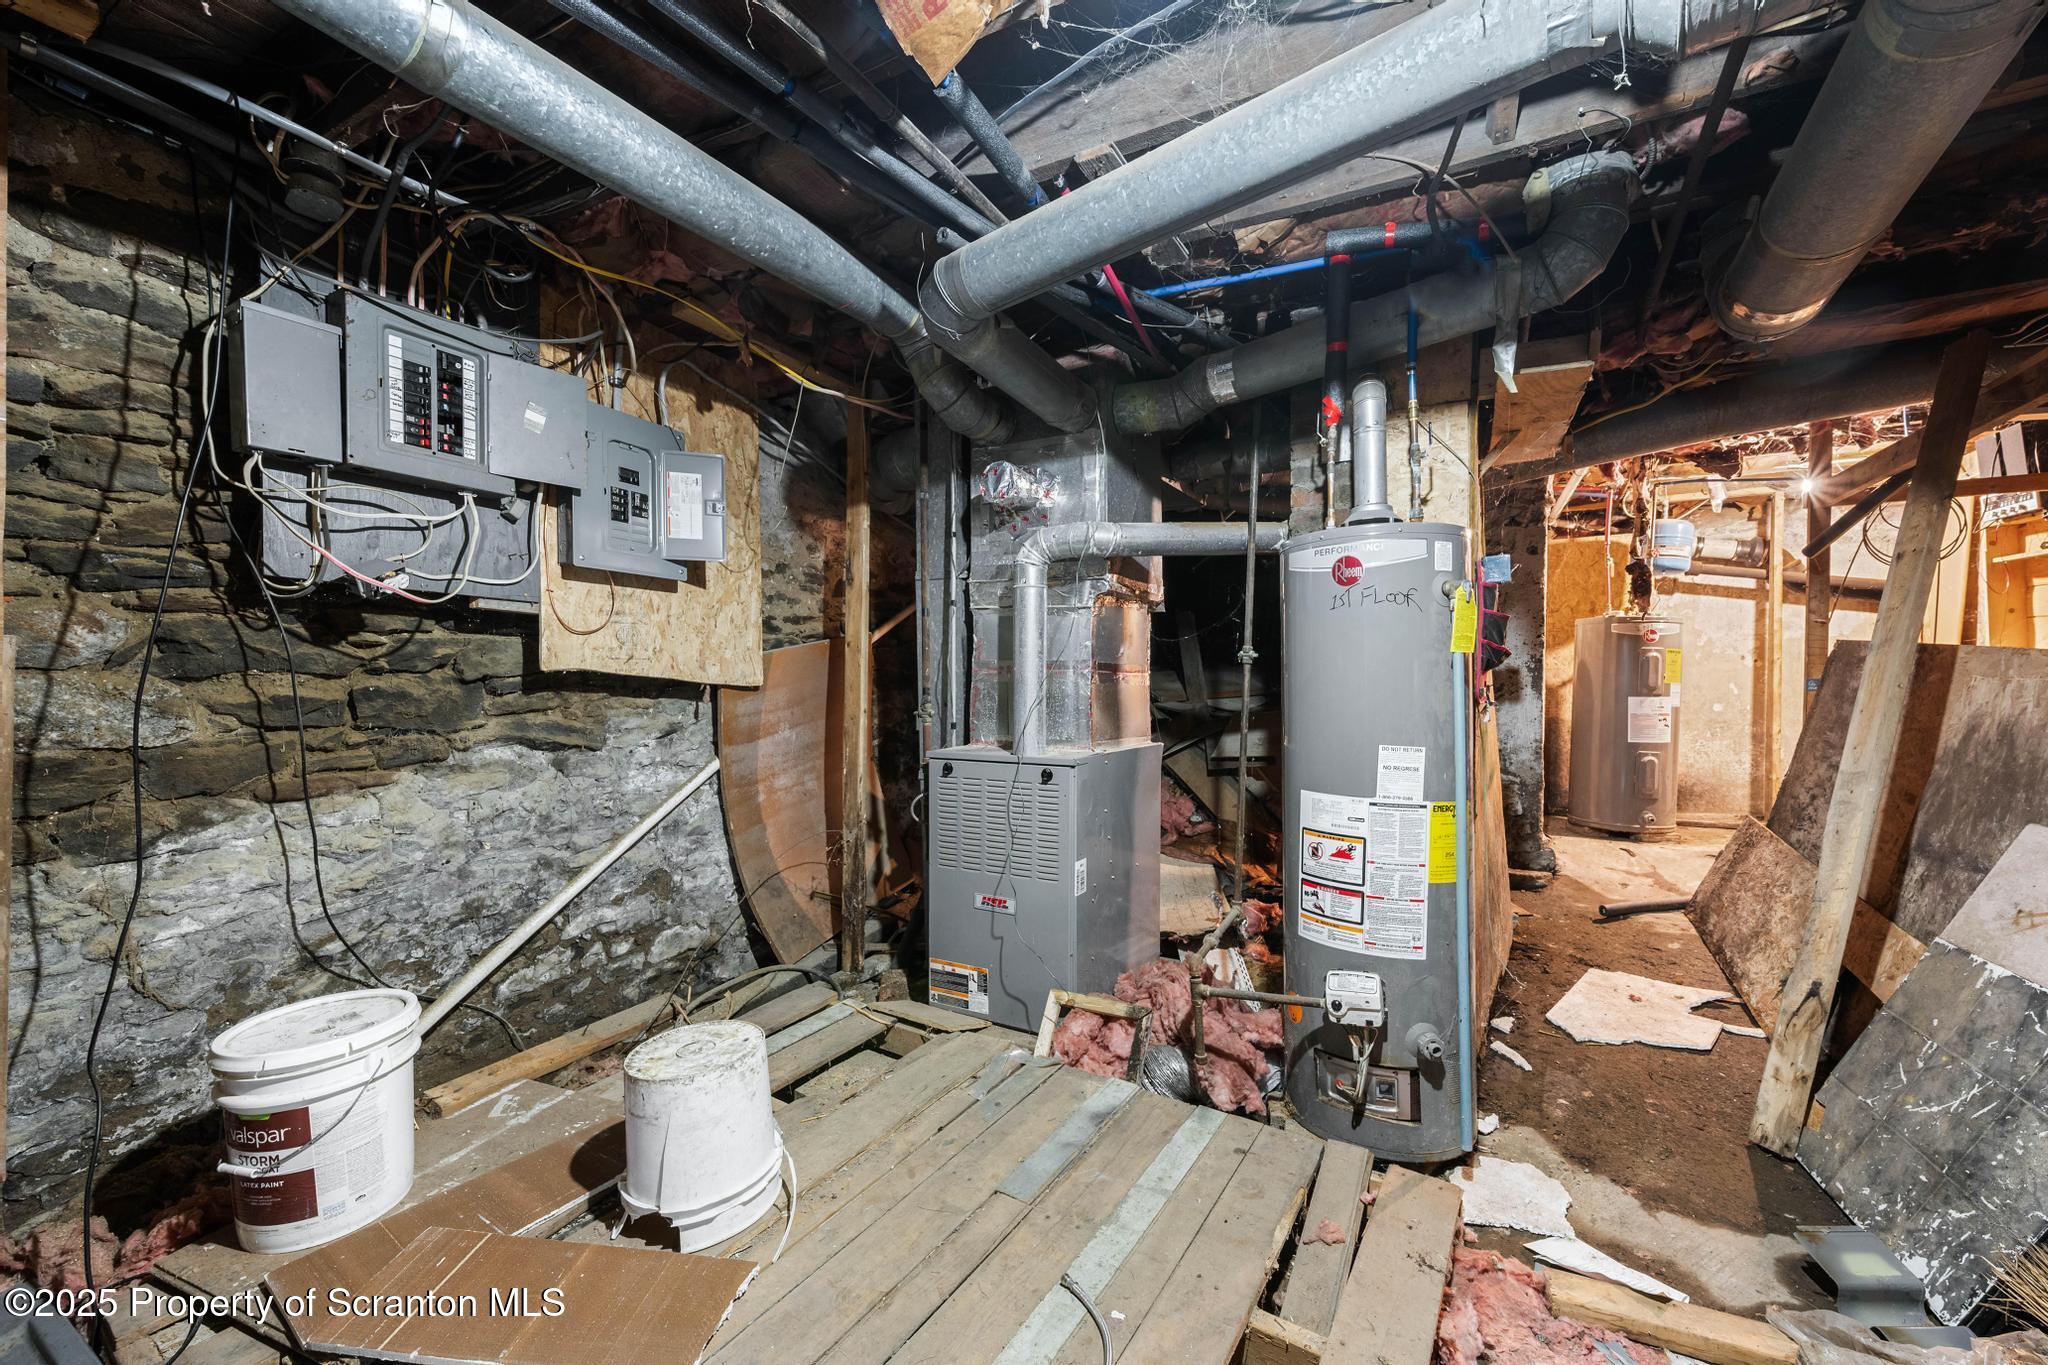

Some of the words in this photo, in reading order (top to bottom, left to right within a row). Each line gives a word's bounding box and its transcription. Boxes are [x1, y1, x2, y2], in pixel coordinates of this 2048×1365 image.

[1335, 557, 1362, 583] Rheem
[1329, 583, 1361, 611] 1ST
[1360, 585, 1423, 613] FLOOR
[230, 1126, 289, 1148] valspar
[238, 1154, 280, 1168] STORM
